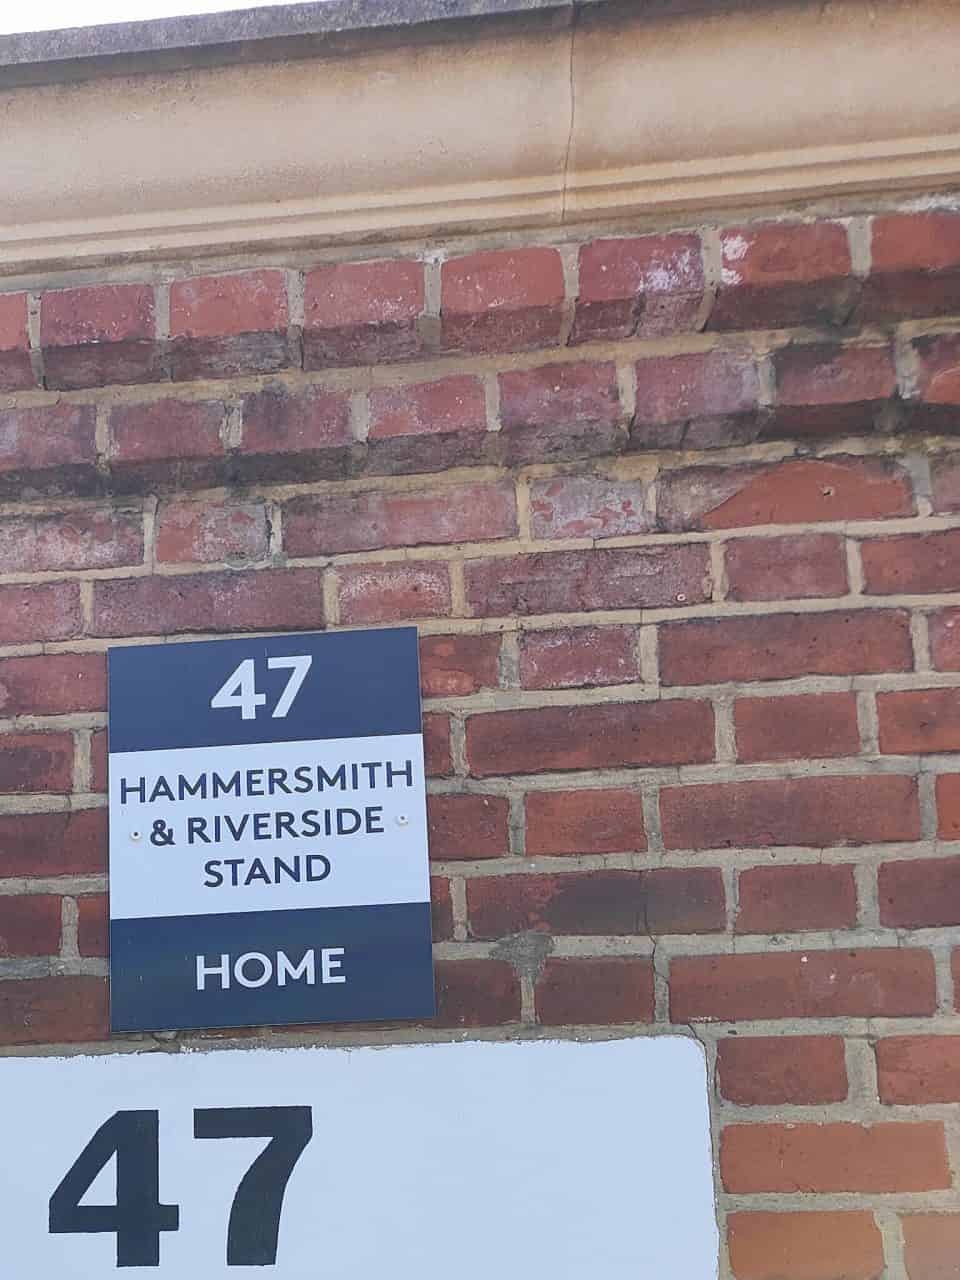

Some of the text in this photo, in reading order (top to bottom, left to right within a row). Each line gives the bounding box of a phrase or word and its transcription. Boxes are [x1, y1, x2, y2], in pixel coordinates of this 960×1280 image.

[210, 655, 313, 720] 47
[120, 760, 413, 805] HAMMERSMITH
[150, 806, 385, 846] & RIVERSIDE
[203, 854, 331, 888] STAND
[196, 947, 346, 990] HOME
[48, 1105, 314, 1268] 47
